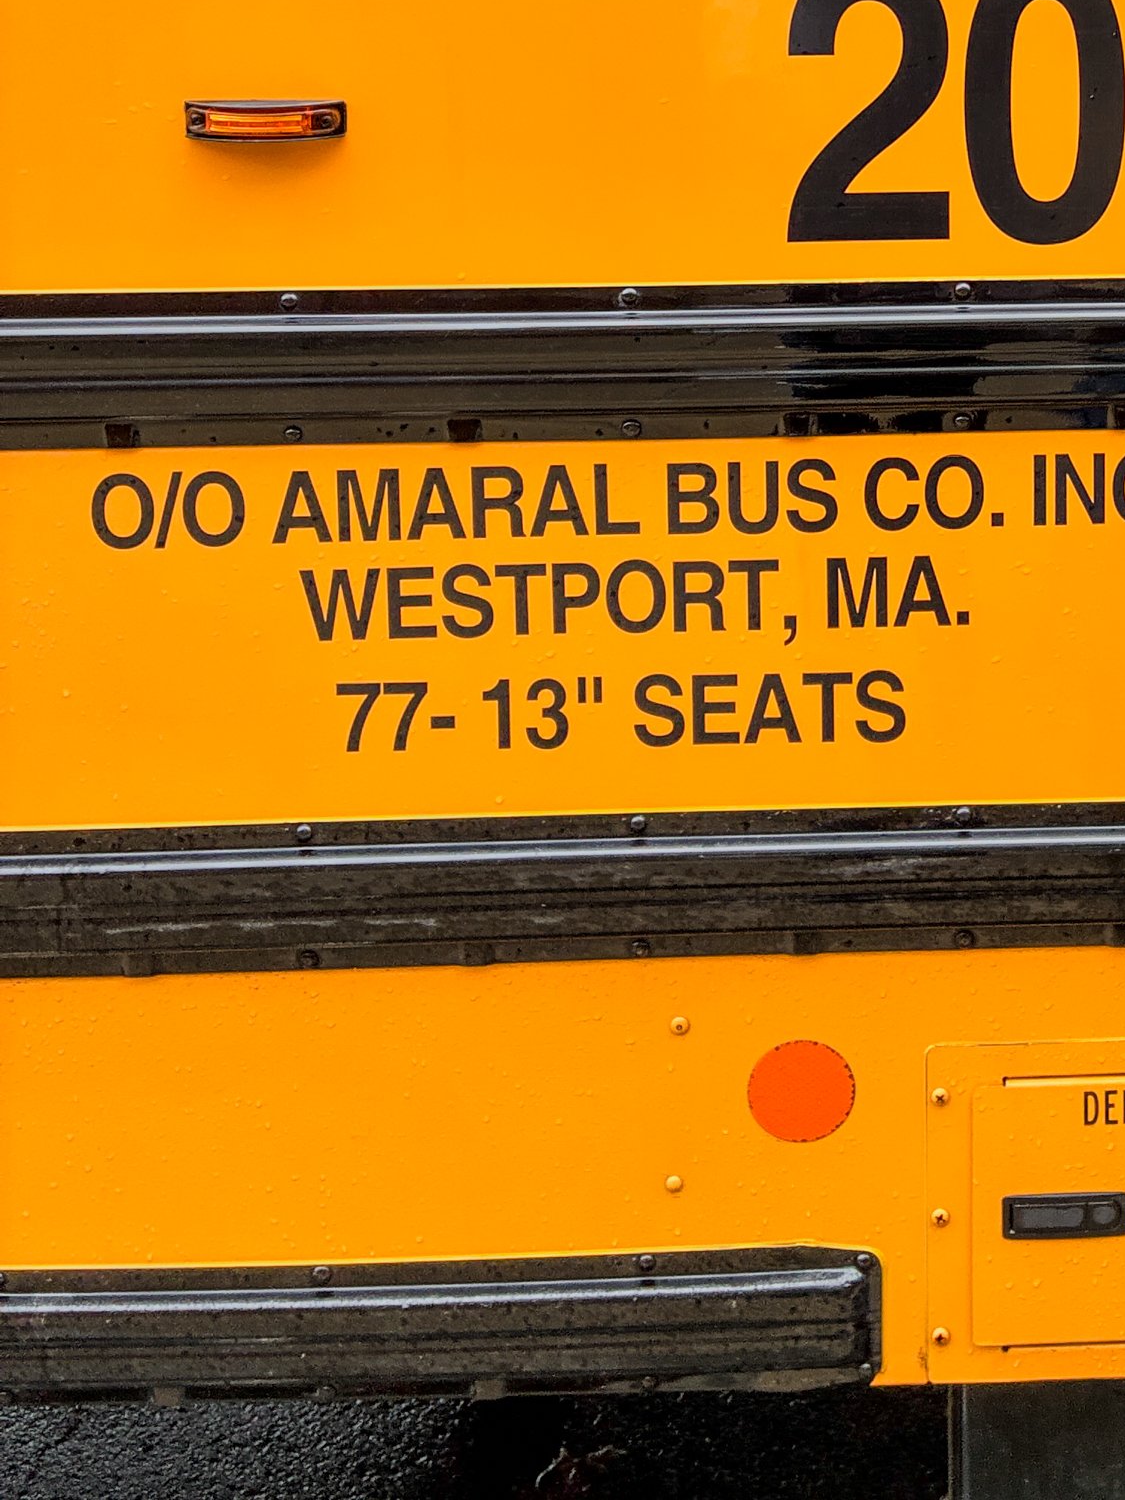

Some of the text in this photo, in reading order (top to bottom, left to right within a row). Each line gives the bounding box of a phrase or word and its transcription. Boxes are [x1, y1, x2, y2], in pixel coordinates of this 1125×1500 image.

[91, 470, 245, 550] O/O
[272, 463, 641, 544] AMARAL
[667, 458, 839, 535] BUS
[865, 453, 1005, 531] CO.
[299, 555, 971, 646] WESTPORT, MA.
[335, 669, 907, 753] 77- 13" SEATS
